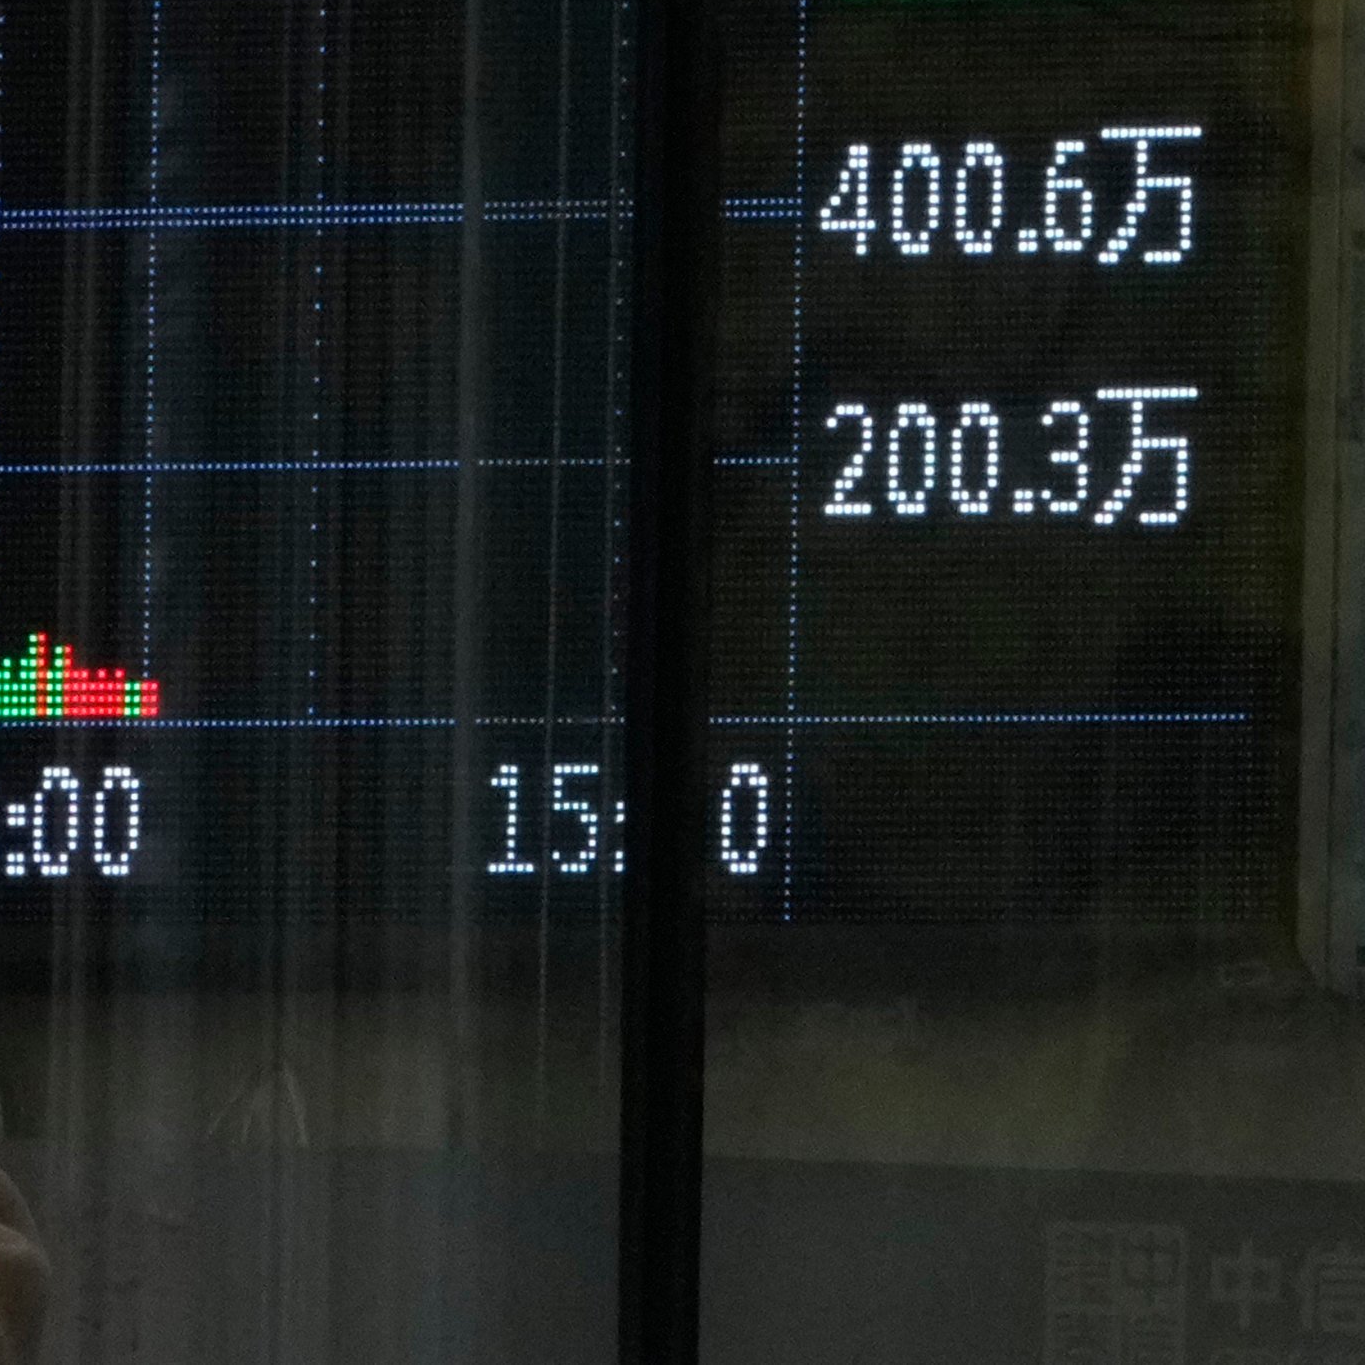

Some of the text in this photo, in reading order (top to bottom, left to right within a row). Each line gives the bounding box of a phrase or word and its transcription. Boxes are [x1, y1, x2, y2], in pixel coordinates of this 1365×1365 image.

[820, 126, 1202, 264] 400.6万
[824, 388, 1199, 525] 200.3万
[487, 763, 767, 875] 15:0
